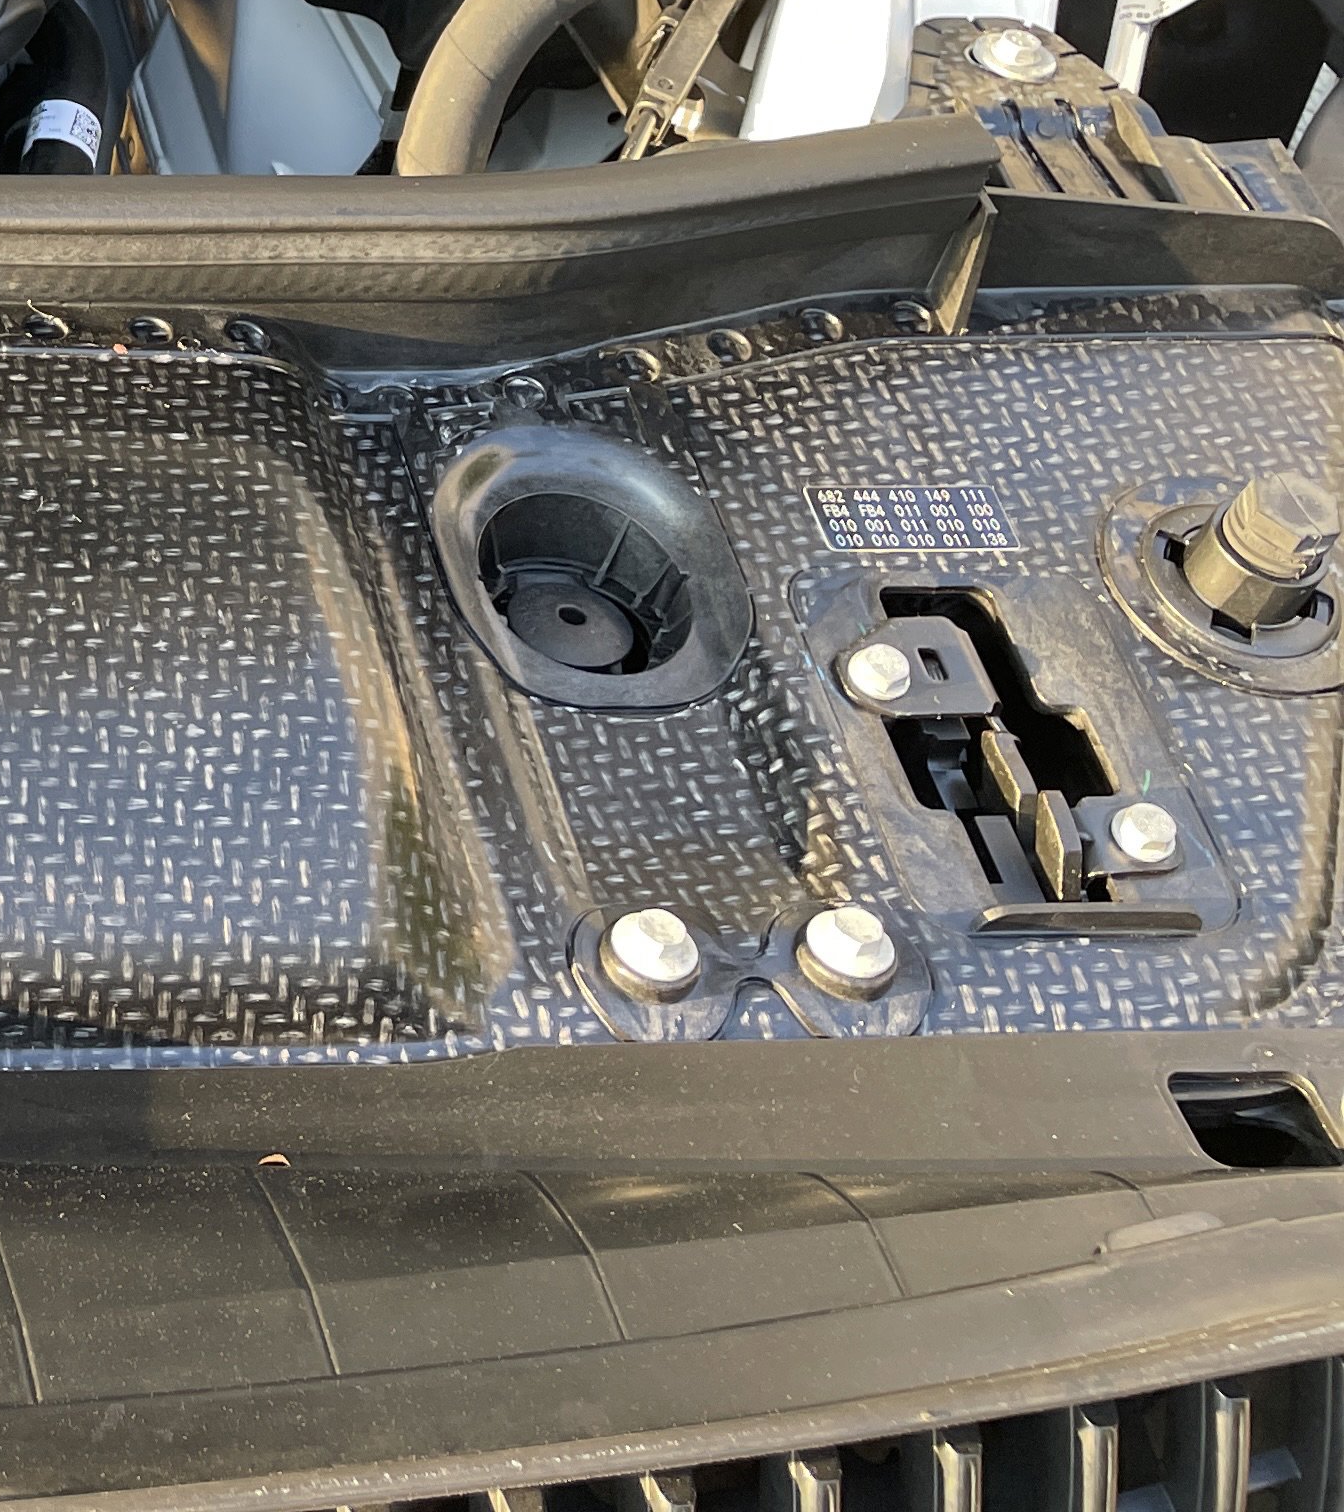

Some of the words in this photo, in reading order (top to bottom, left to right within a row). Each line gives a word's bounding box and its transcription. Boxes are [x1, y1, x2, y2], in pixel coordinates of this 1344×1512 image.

[853, 489, 880, 503] 444
[888, 489, 916, 503] 410
[924, 489, 950, 503] 149
[960, 489, 986, 503] 111
[822, 504, 850, 517] FB4
[858, 504, 885, 517] FB4
[894, 504, 922, 517] 011
[930, 504, 957, 517] 001
[966, 504, 993, 517] 100
[829, 519, 857, 532] 010
[865, 519, 893, 532] 001
[900, 519, 928, 532] 011
[936, 519, 964, 532] 010
[972, 519, 1000, 532] 010
[835, 533, 864, 547] 010
[871, 533, 899, 547] 010
[907, 533, 936, 547] 010
[943, 533, 970, 547] 011
